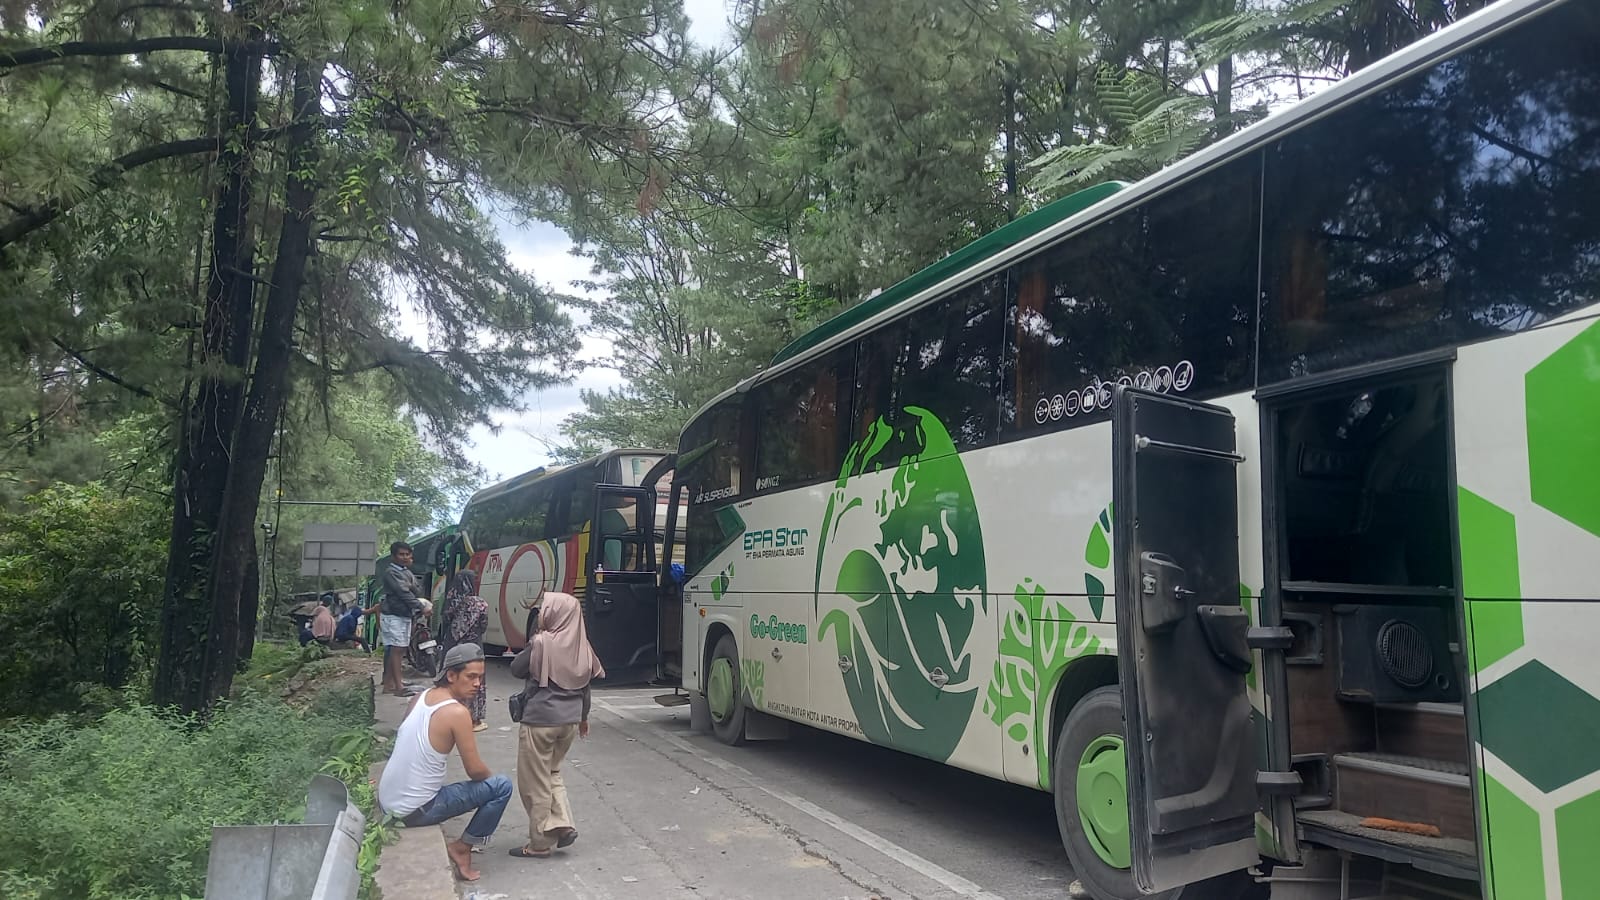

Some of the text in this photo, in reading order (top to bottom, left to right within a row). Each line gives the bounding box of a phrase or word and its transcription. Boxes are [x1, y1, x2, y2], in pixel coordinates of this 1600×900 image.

[694, 487, 738, 505] AIR SUSPENSION
[743, 527, 809, 551] EPA Star
[762, 548, 785, 559] PERMATA
[786, 546, 805, 557] AGUNG
[750, 614, 807, 644] Go-Green
[768, 701, 790, 714] ANGKUTAN
[791, 706, 806, 719] ANTAR
[806, 709, 820, 722] KOTA
[820, 713, 838, 727] ANTAR
